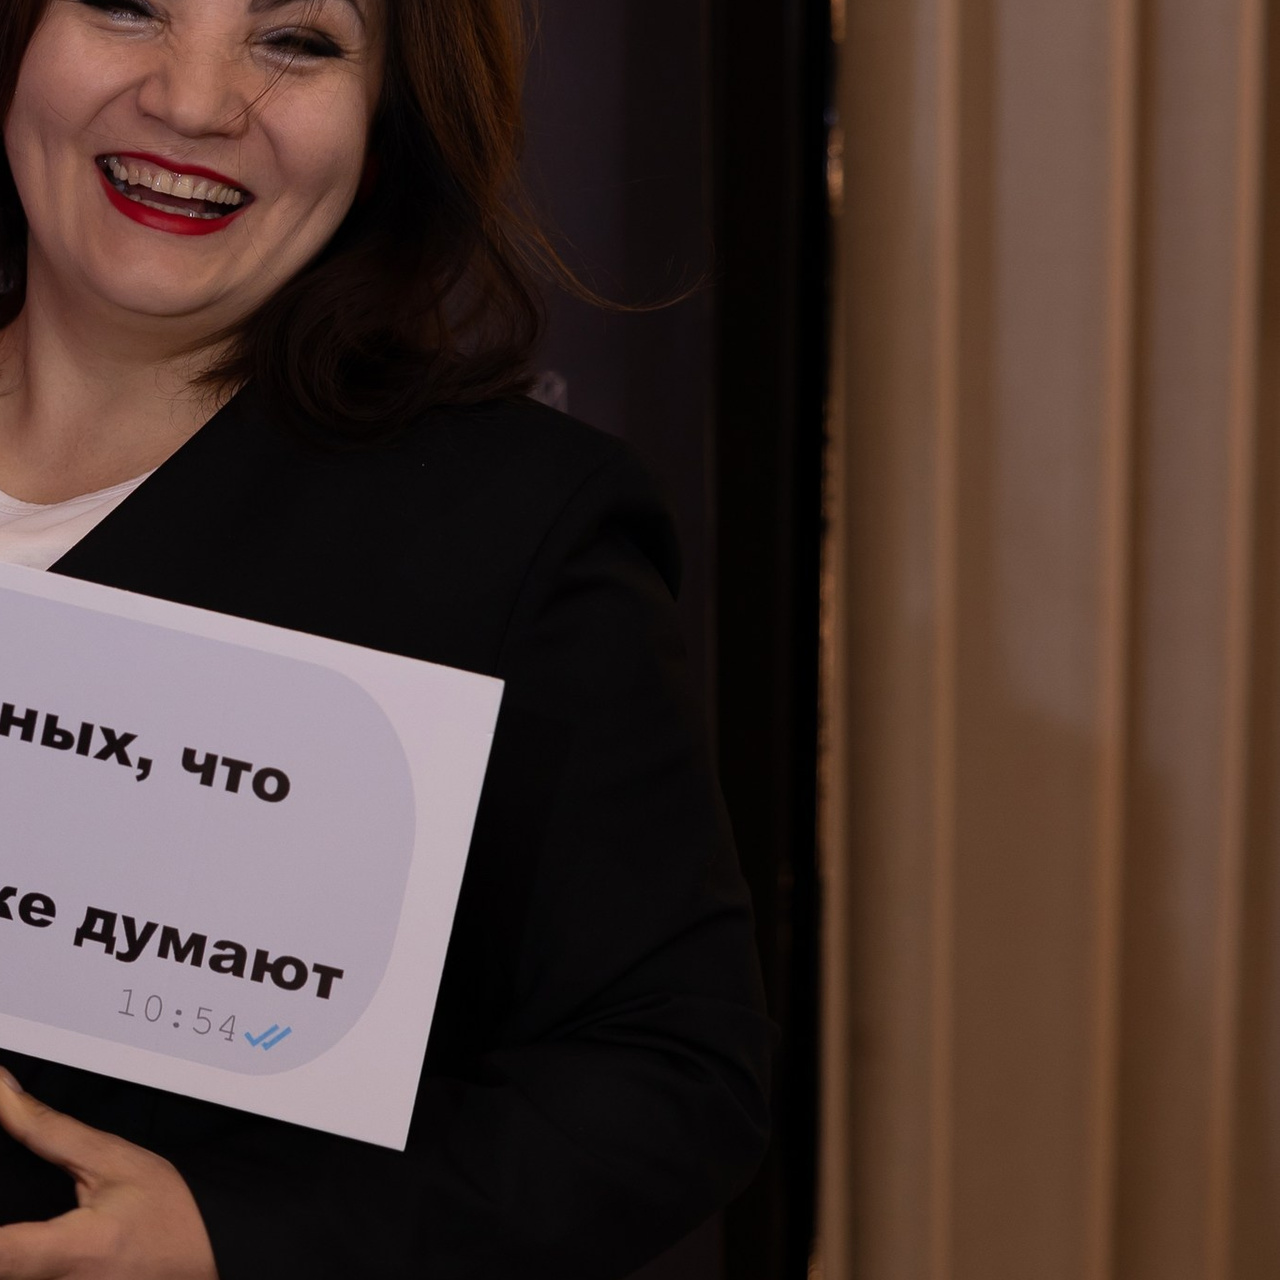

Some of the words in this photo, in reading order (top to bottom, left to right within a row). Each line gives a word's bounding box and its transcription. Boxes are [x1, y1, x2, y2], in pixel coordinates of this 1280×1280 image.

[181, 747, 291, 803] что
[73, 906, 344, 1000] думают
[117, 987, 237, 1043] 10:54
